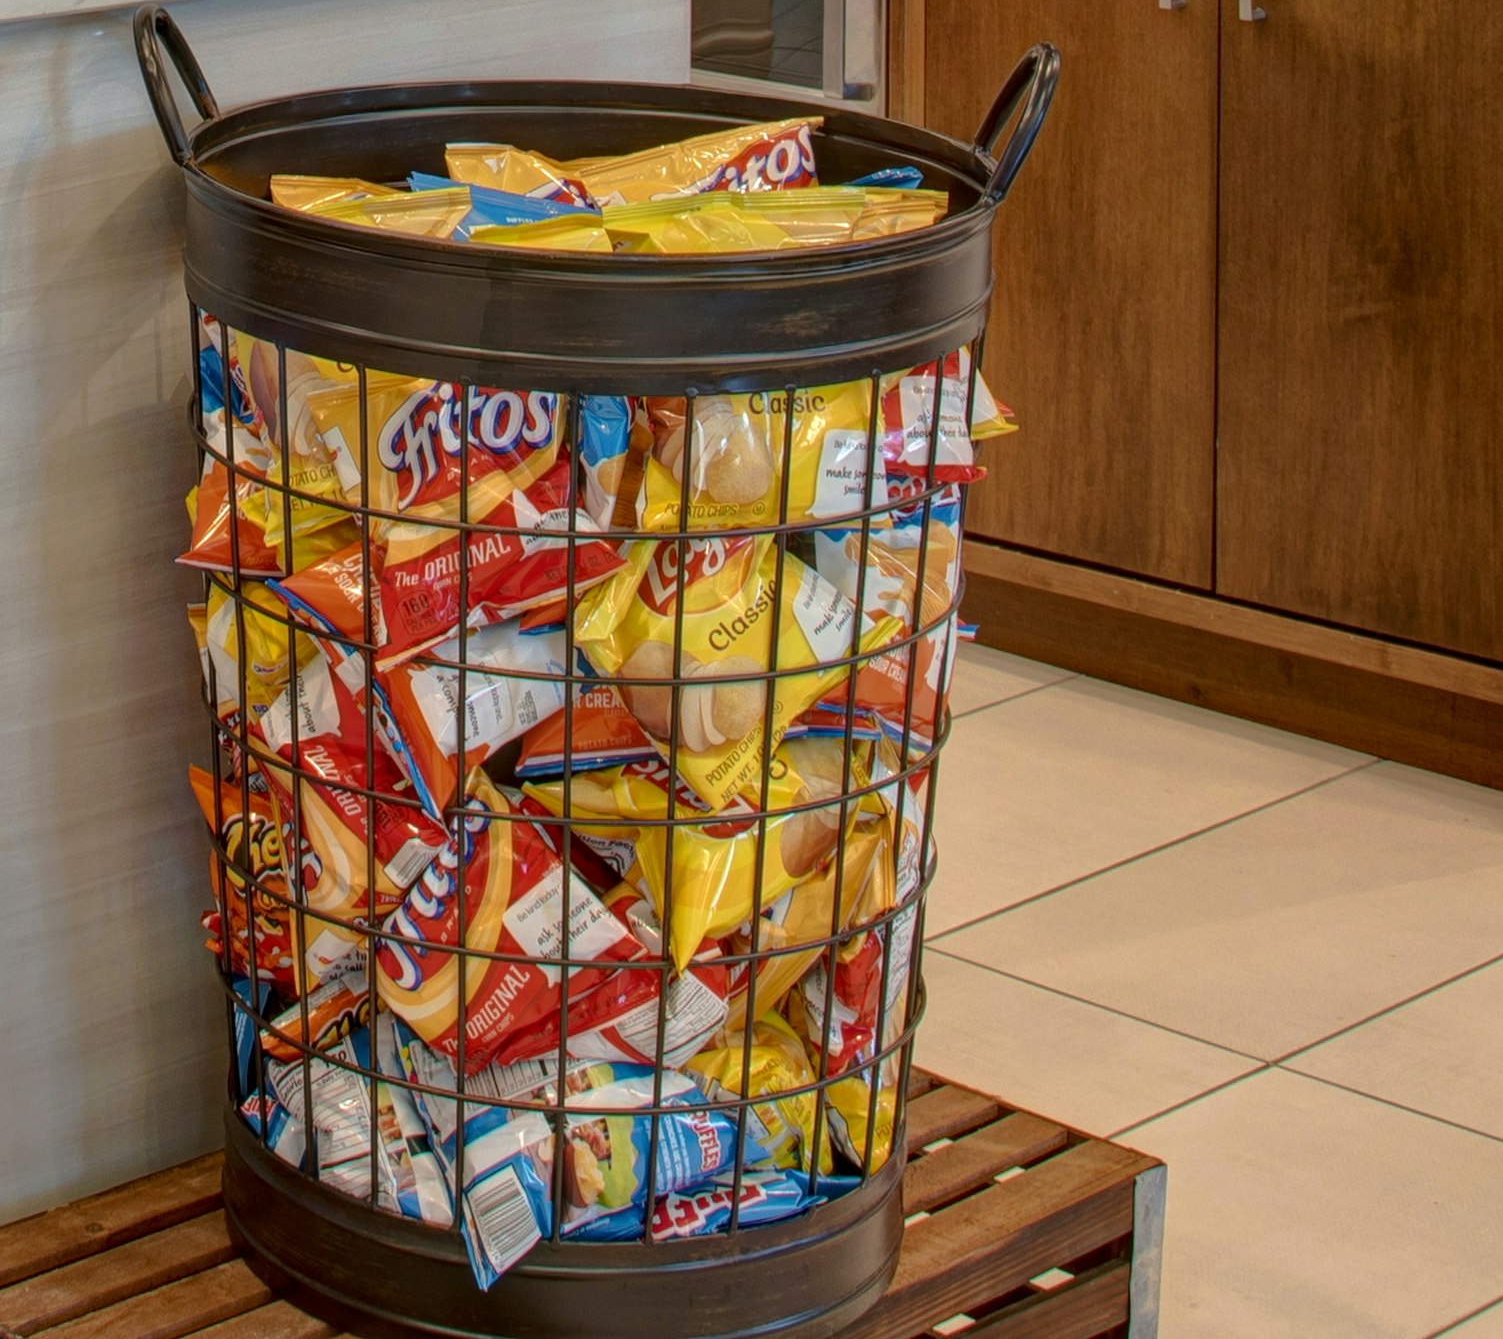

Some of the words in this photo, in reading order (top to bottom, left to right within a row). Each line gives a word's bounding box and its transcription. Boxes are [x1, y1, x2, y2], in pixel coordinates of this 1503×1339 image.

[378, 381, 557, 512] Fritos
[825, 466, 852, 480] make
[706, 504, 737, 517] CHIPS
[393, 570, 419, 587] The
[709, 578, 778, 652] Classic
[704, 749, 742, 788] POTATO
[736, 725, 762, 760] CHIPS
[720, 782, 741, 804] NET
[537, 928, 555, 946] ask
[464, 964, 530, 1040] ORIGINAL
